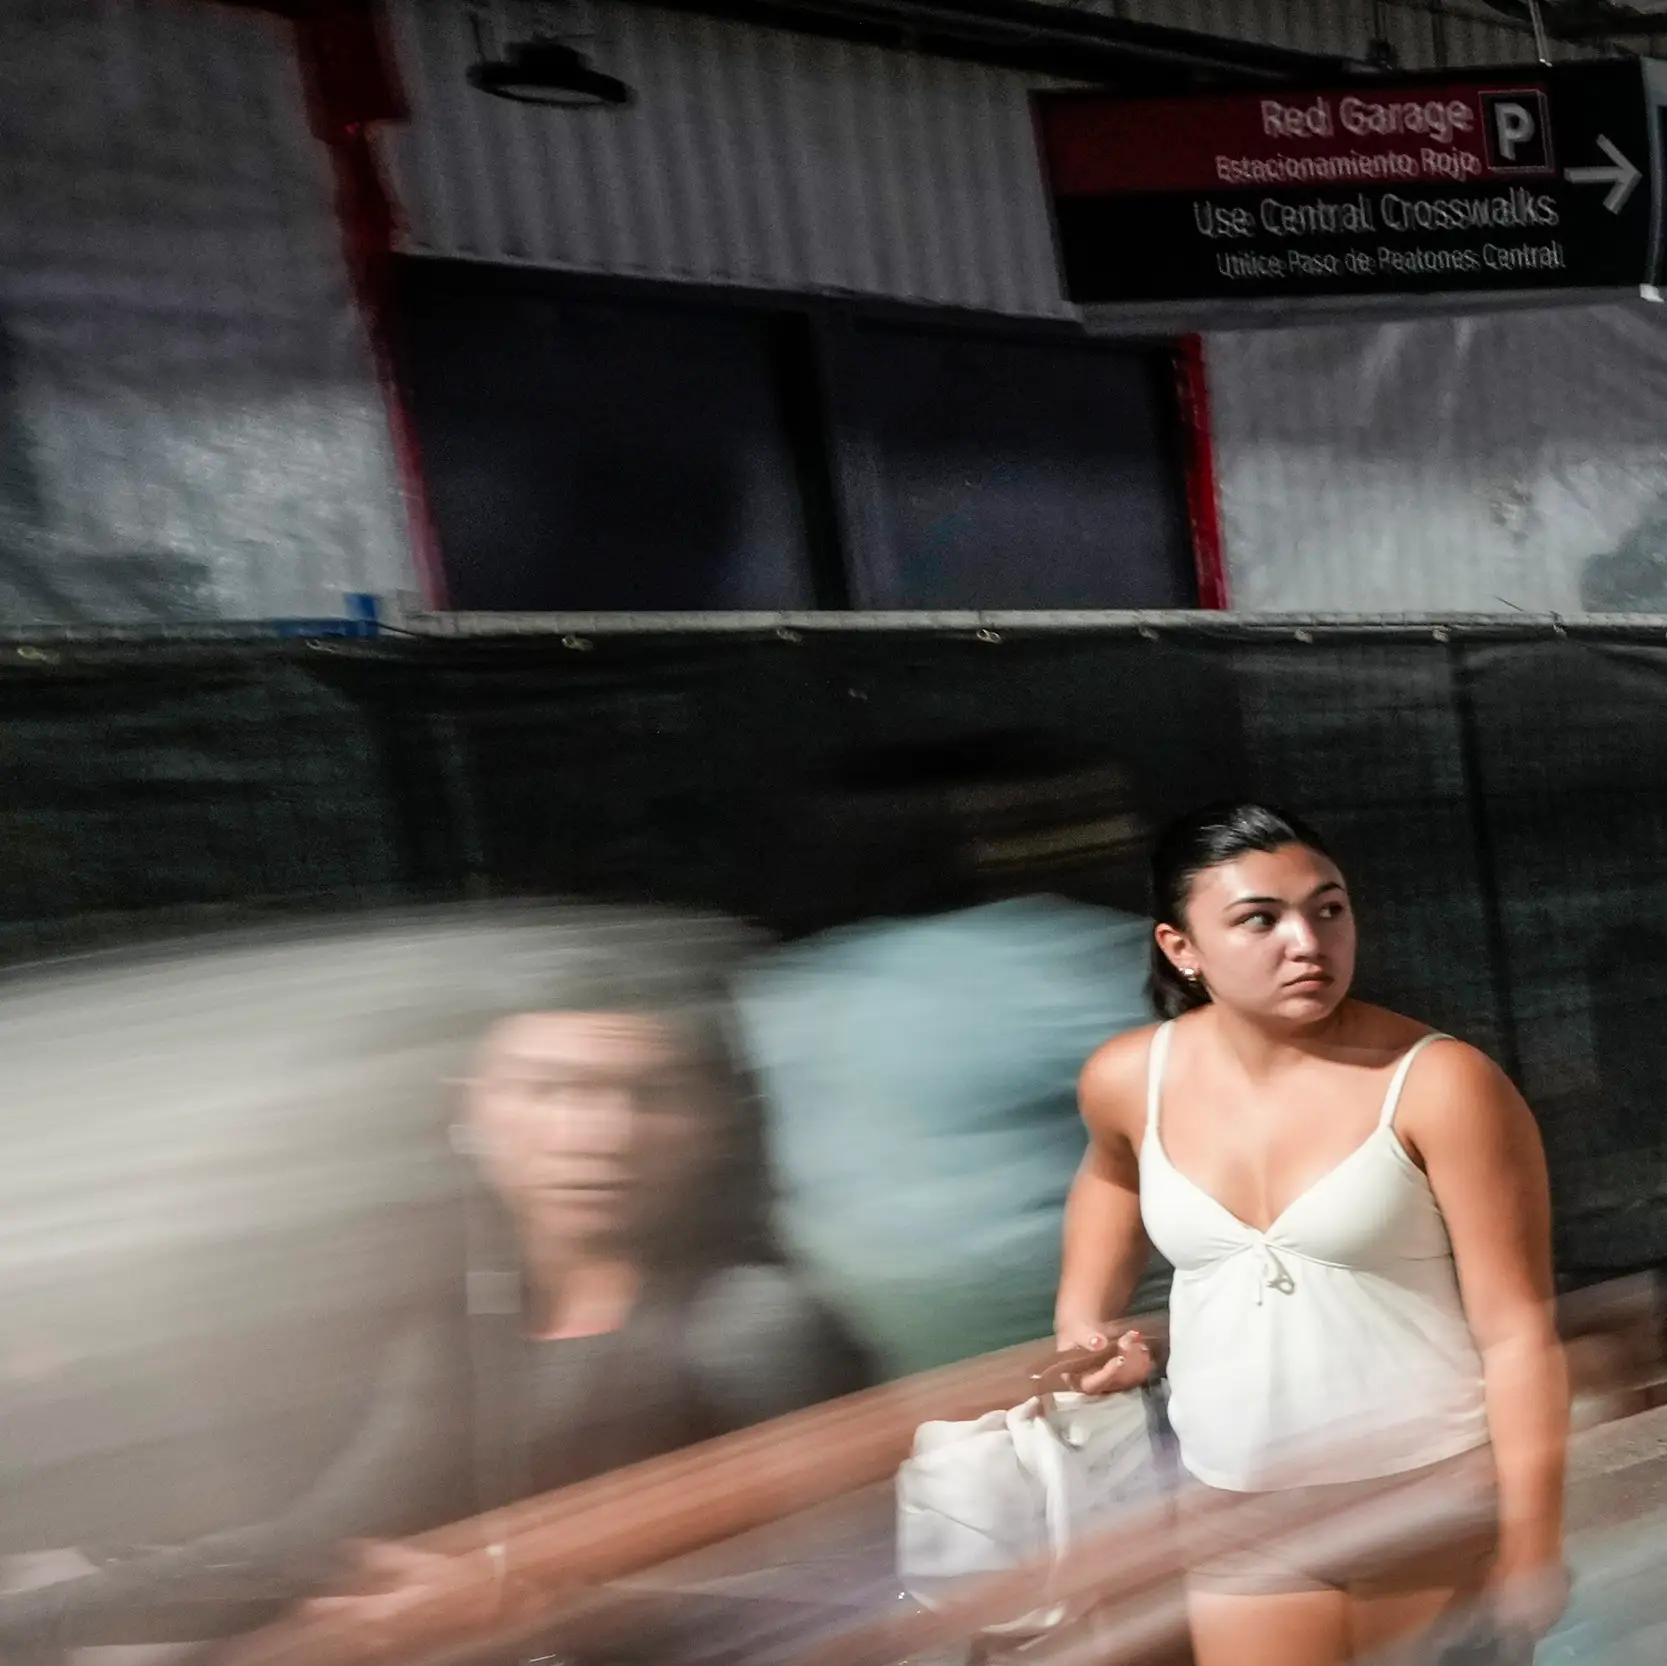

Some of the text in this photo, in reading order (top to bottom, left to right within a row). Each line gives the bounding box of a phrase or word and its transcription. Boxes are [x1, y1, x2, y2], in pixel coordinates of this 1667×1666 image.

[1260, 96, 1475, 143] Red Garage
[1494, 102, 1535, 161] P
[1214, 147, 1481, 183] Estacionamiento Rojo
[1193, 187, 1560, 237] Use Central Crosswalks
[1216, 240, 1566, 278] Utilice Paso de Peatones Central
